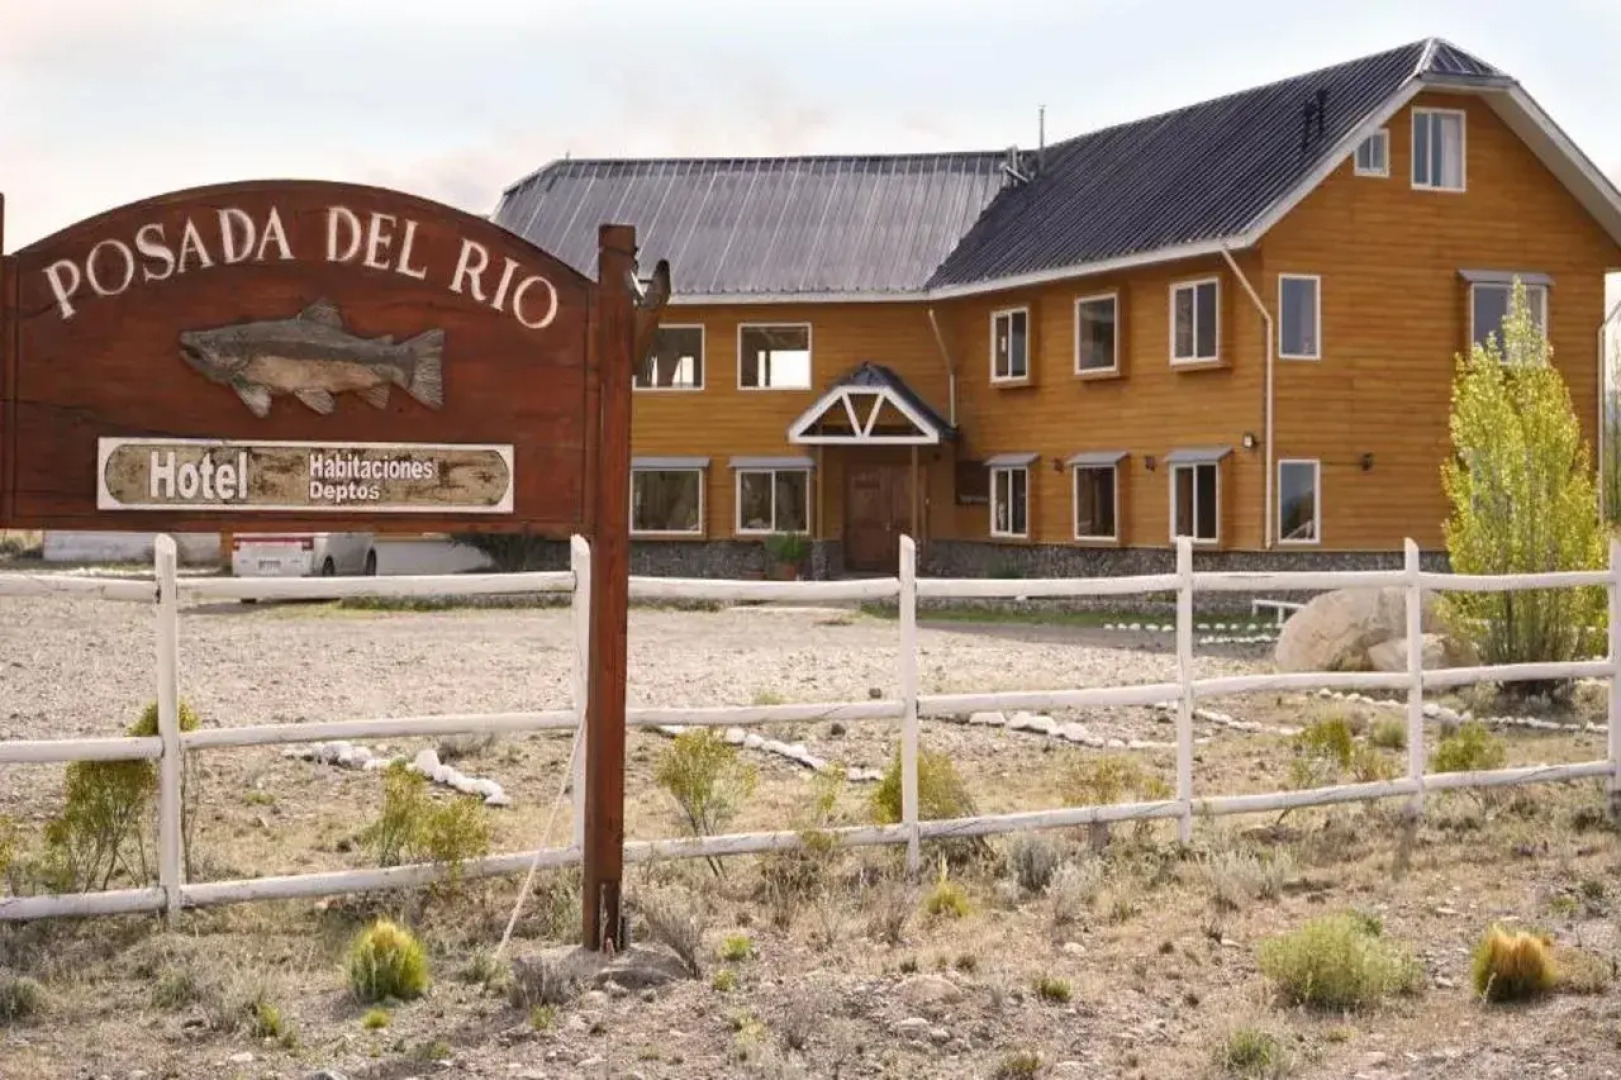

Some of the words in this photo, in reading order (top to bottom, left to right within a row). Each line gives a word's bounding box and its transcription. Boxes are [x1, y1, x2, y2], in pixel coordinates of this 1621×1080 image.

[43, 206, 295, 319] POSADA
[326, 206, 427, 280] DEL
[449, 238, 558, 329] RIO
[149, 450, 249, 498] Hotel
[308, 454, 433, 479] Habitaciones
[309, 481, 380, 501] Deptos
